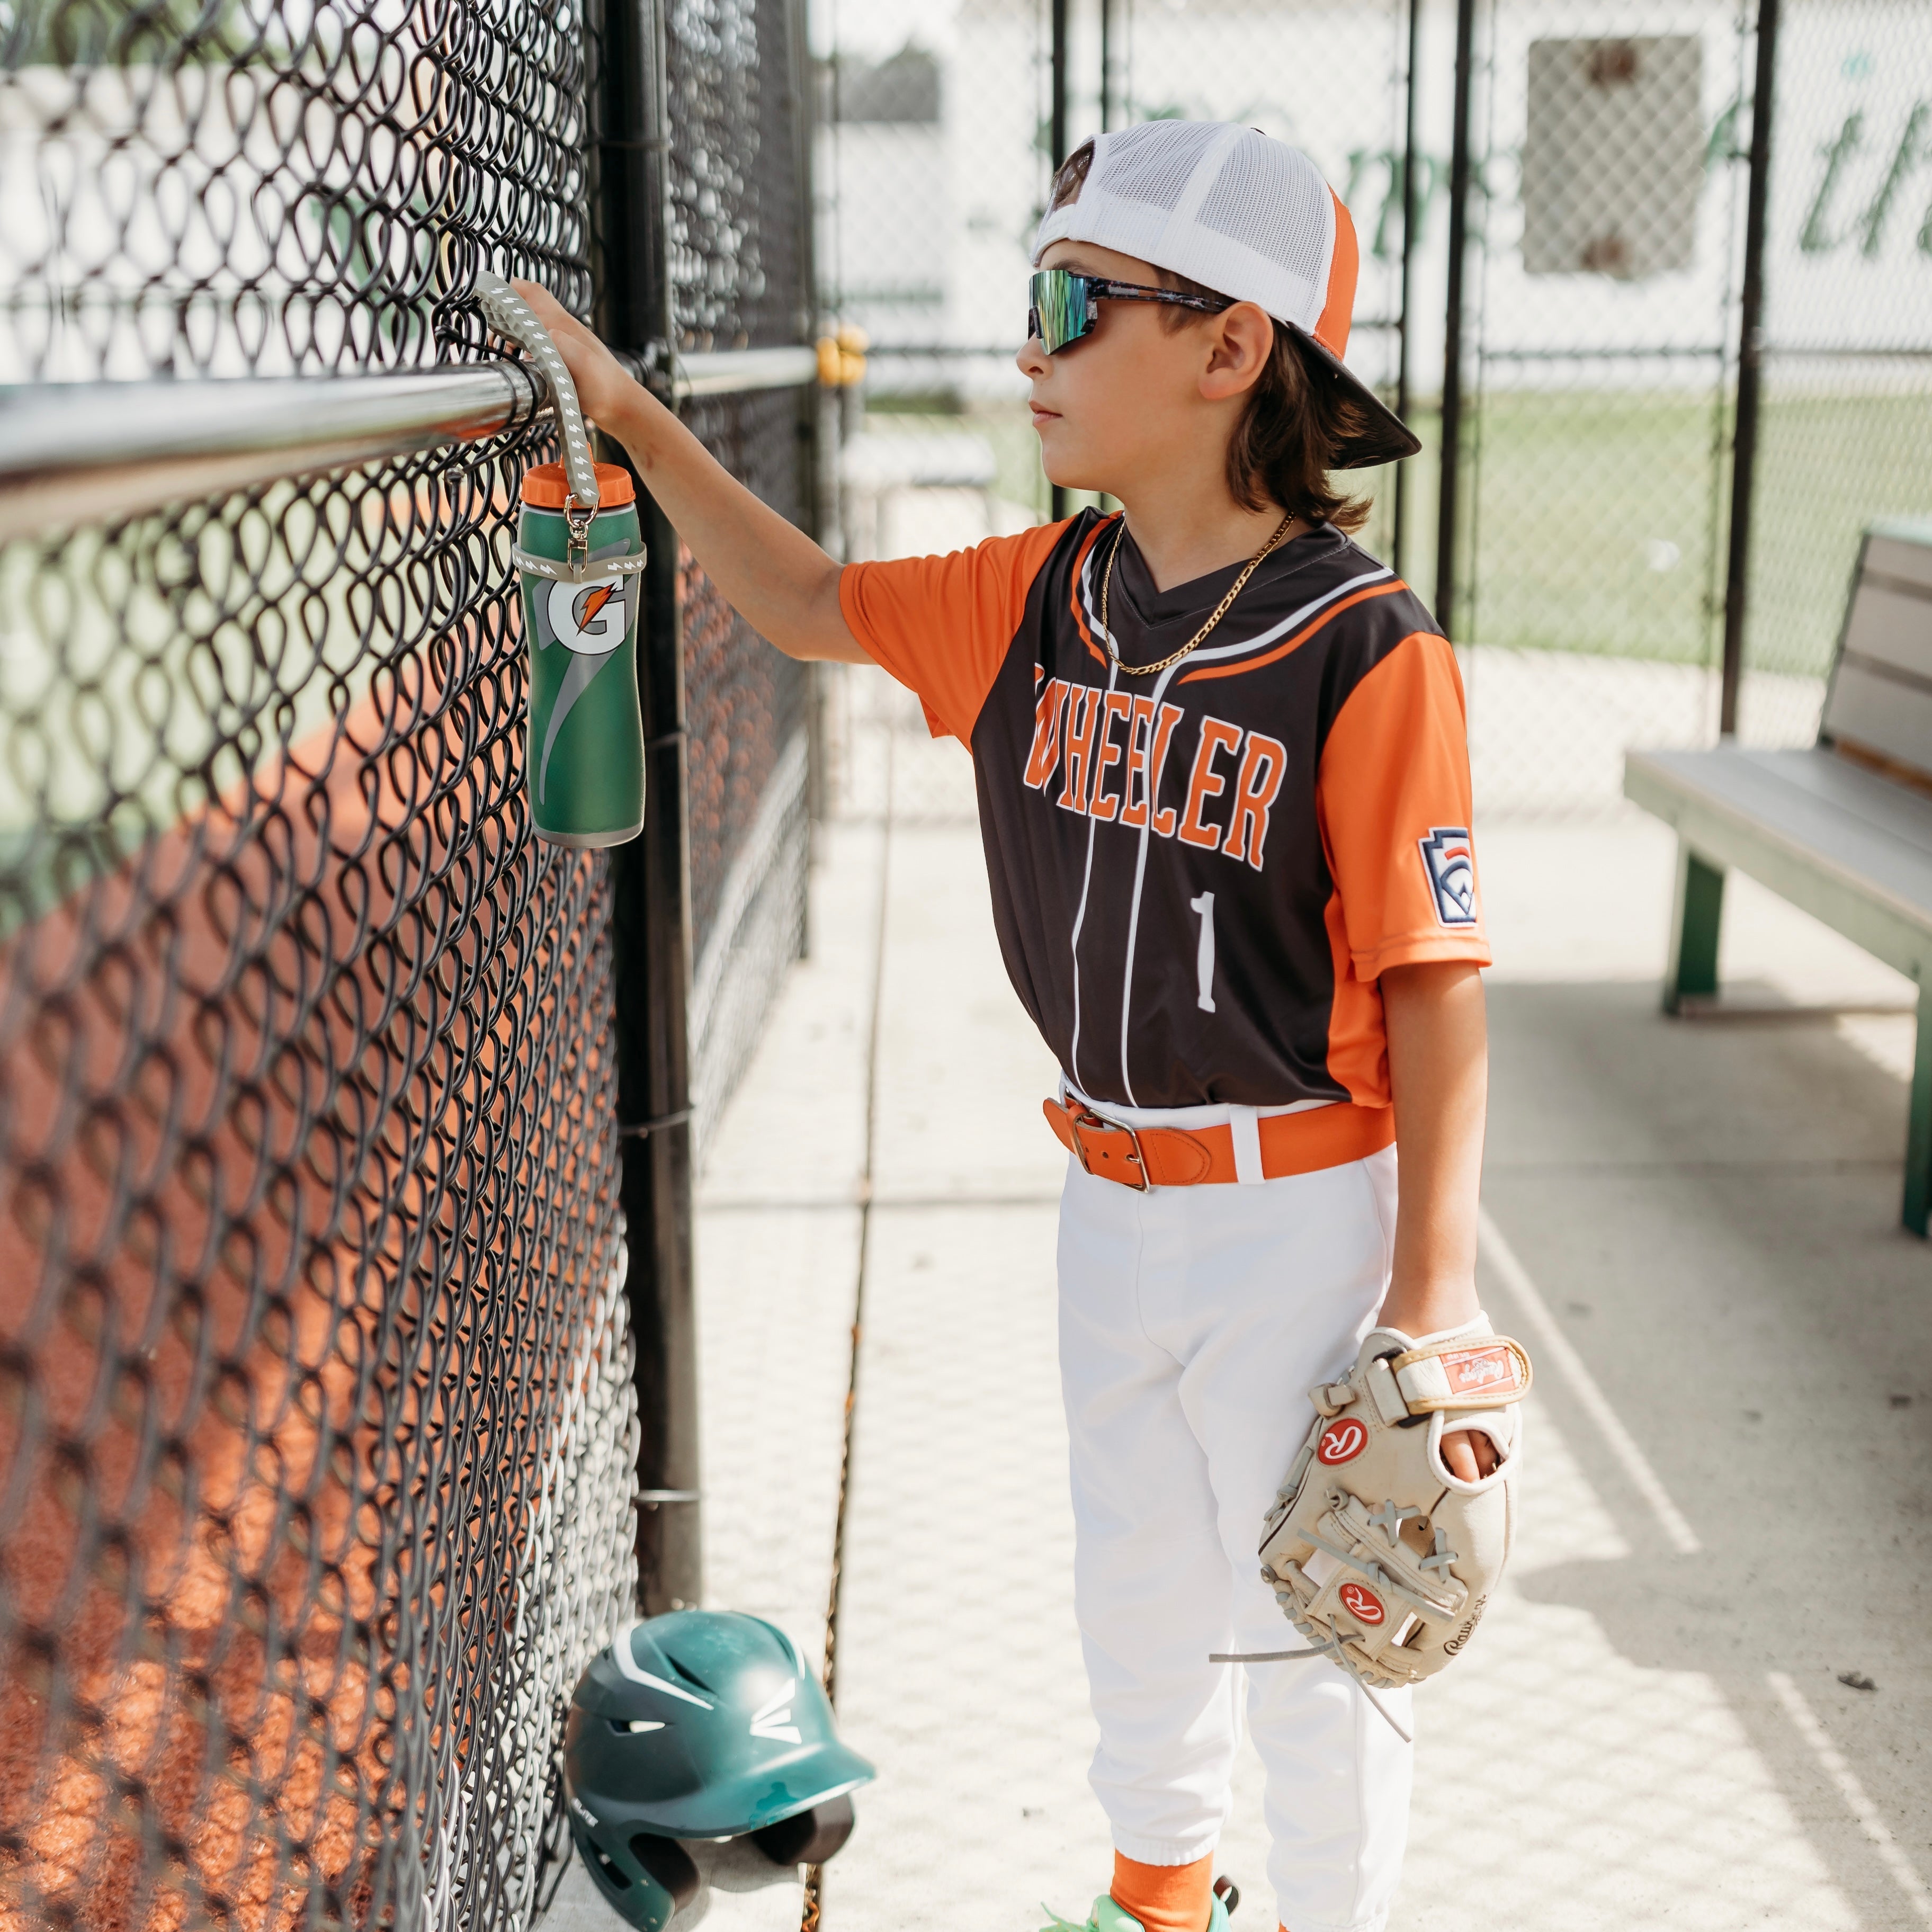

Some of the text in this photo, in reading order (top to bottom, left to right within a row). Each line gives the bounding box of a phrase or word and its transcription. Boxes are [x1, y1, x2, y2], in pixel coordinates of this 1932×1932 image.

[547, 574, 626, 656] G
[1023, 662, 1287, 872] WHEELER
[1190, 891, 1216, 1013] 1
[1325, 1426, 1362, 1459] R
[1346, 1587, 1382, 1620] R
